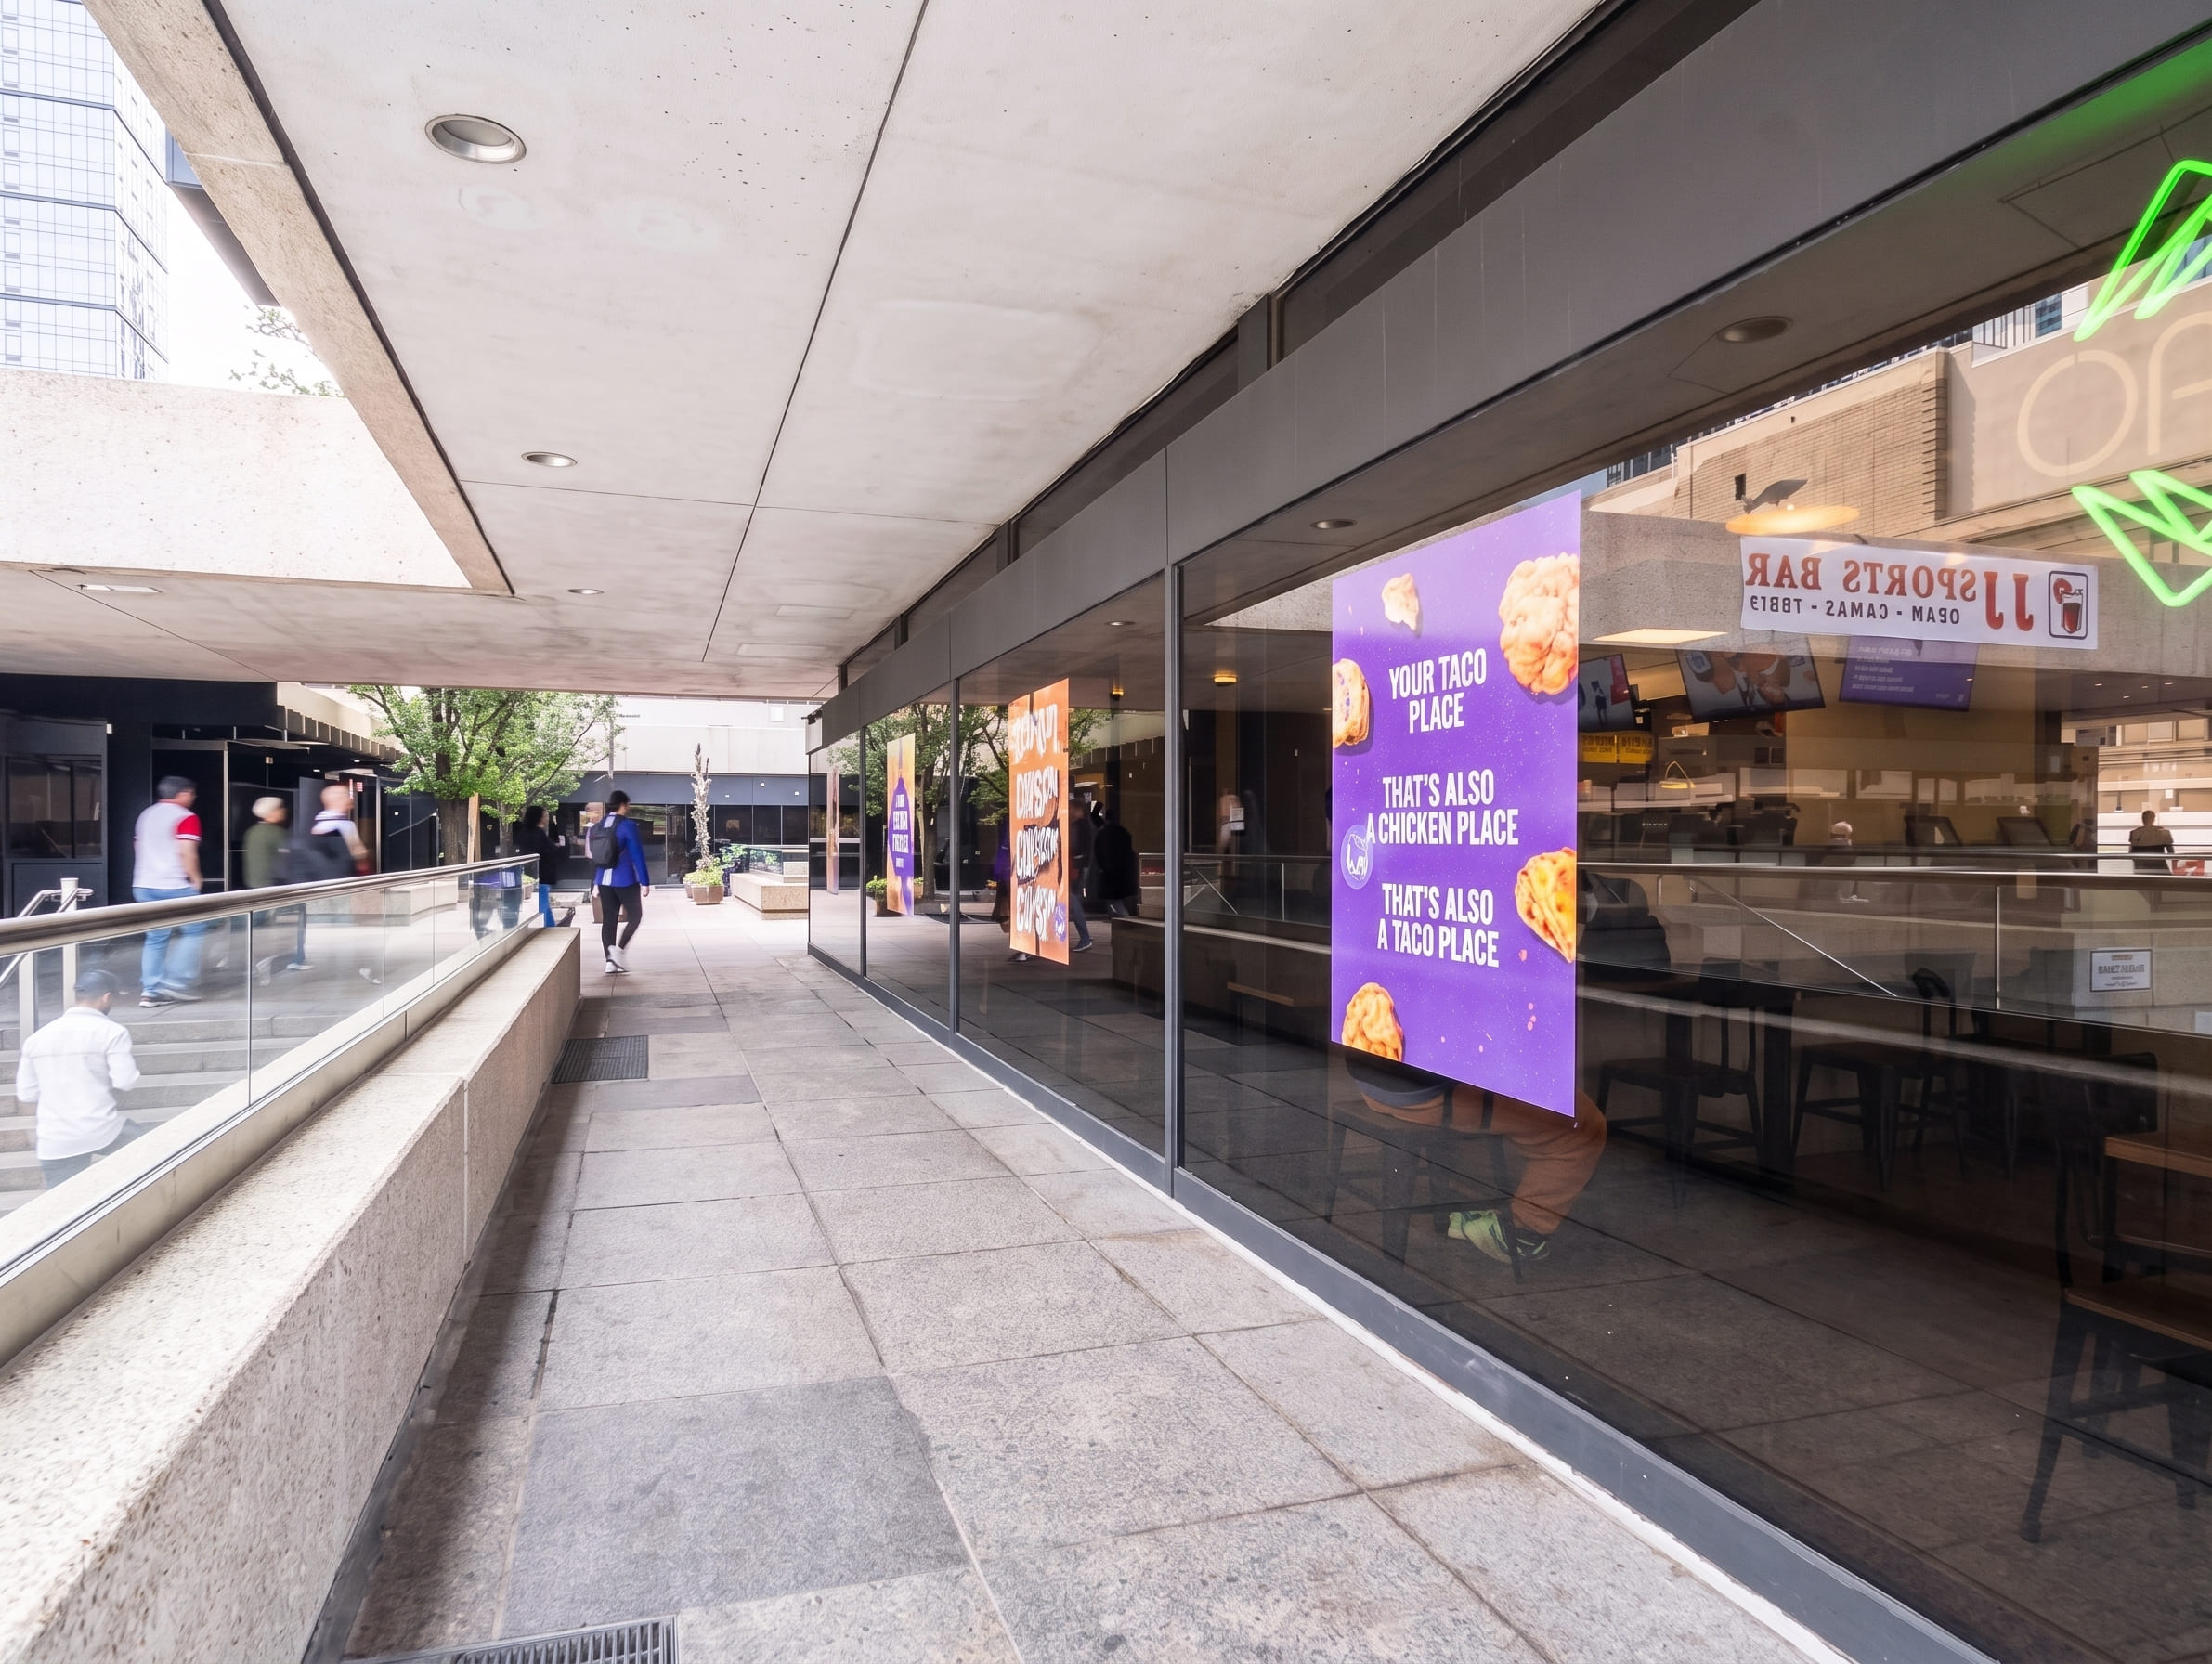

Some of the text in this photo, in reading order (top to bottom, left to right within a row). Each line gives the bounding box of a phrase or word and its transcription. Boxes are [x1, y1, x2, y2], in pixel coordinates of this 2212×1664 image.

[1388, 647, 1487, 700] YOUR TACO
[1409, 692, 1464, 734] PLACE
[1444, 769, 1494, 806] ALSO
[1366, 808, 1519, 845] A CHICKEN PLACE
[1381, 883, 1494, 926] THAT'S ALSO
[1376, 918, 1500, 968] A TACO PLACE
